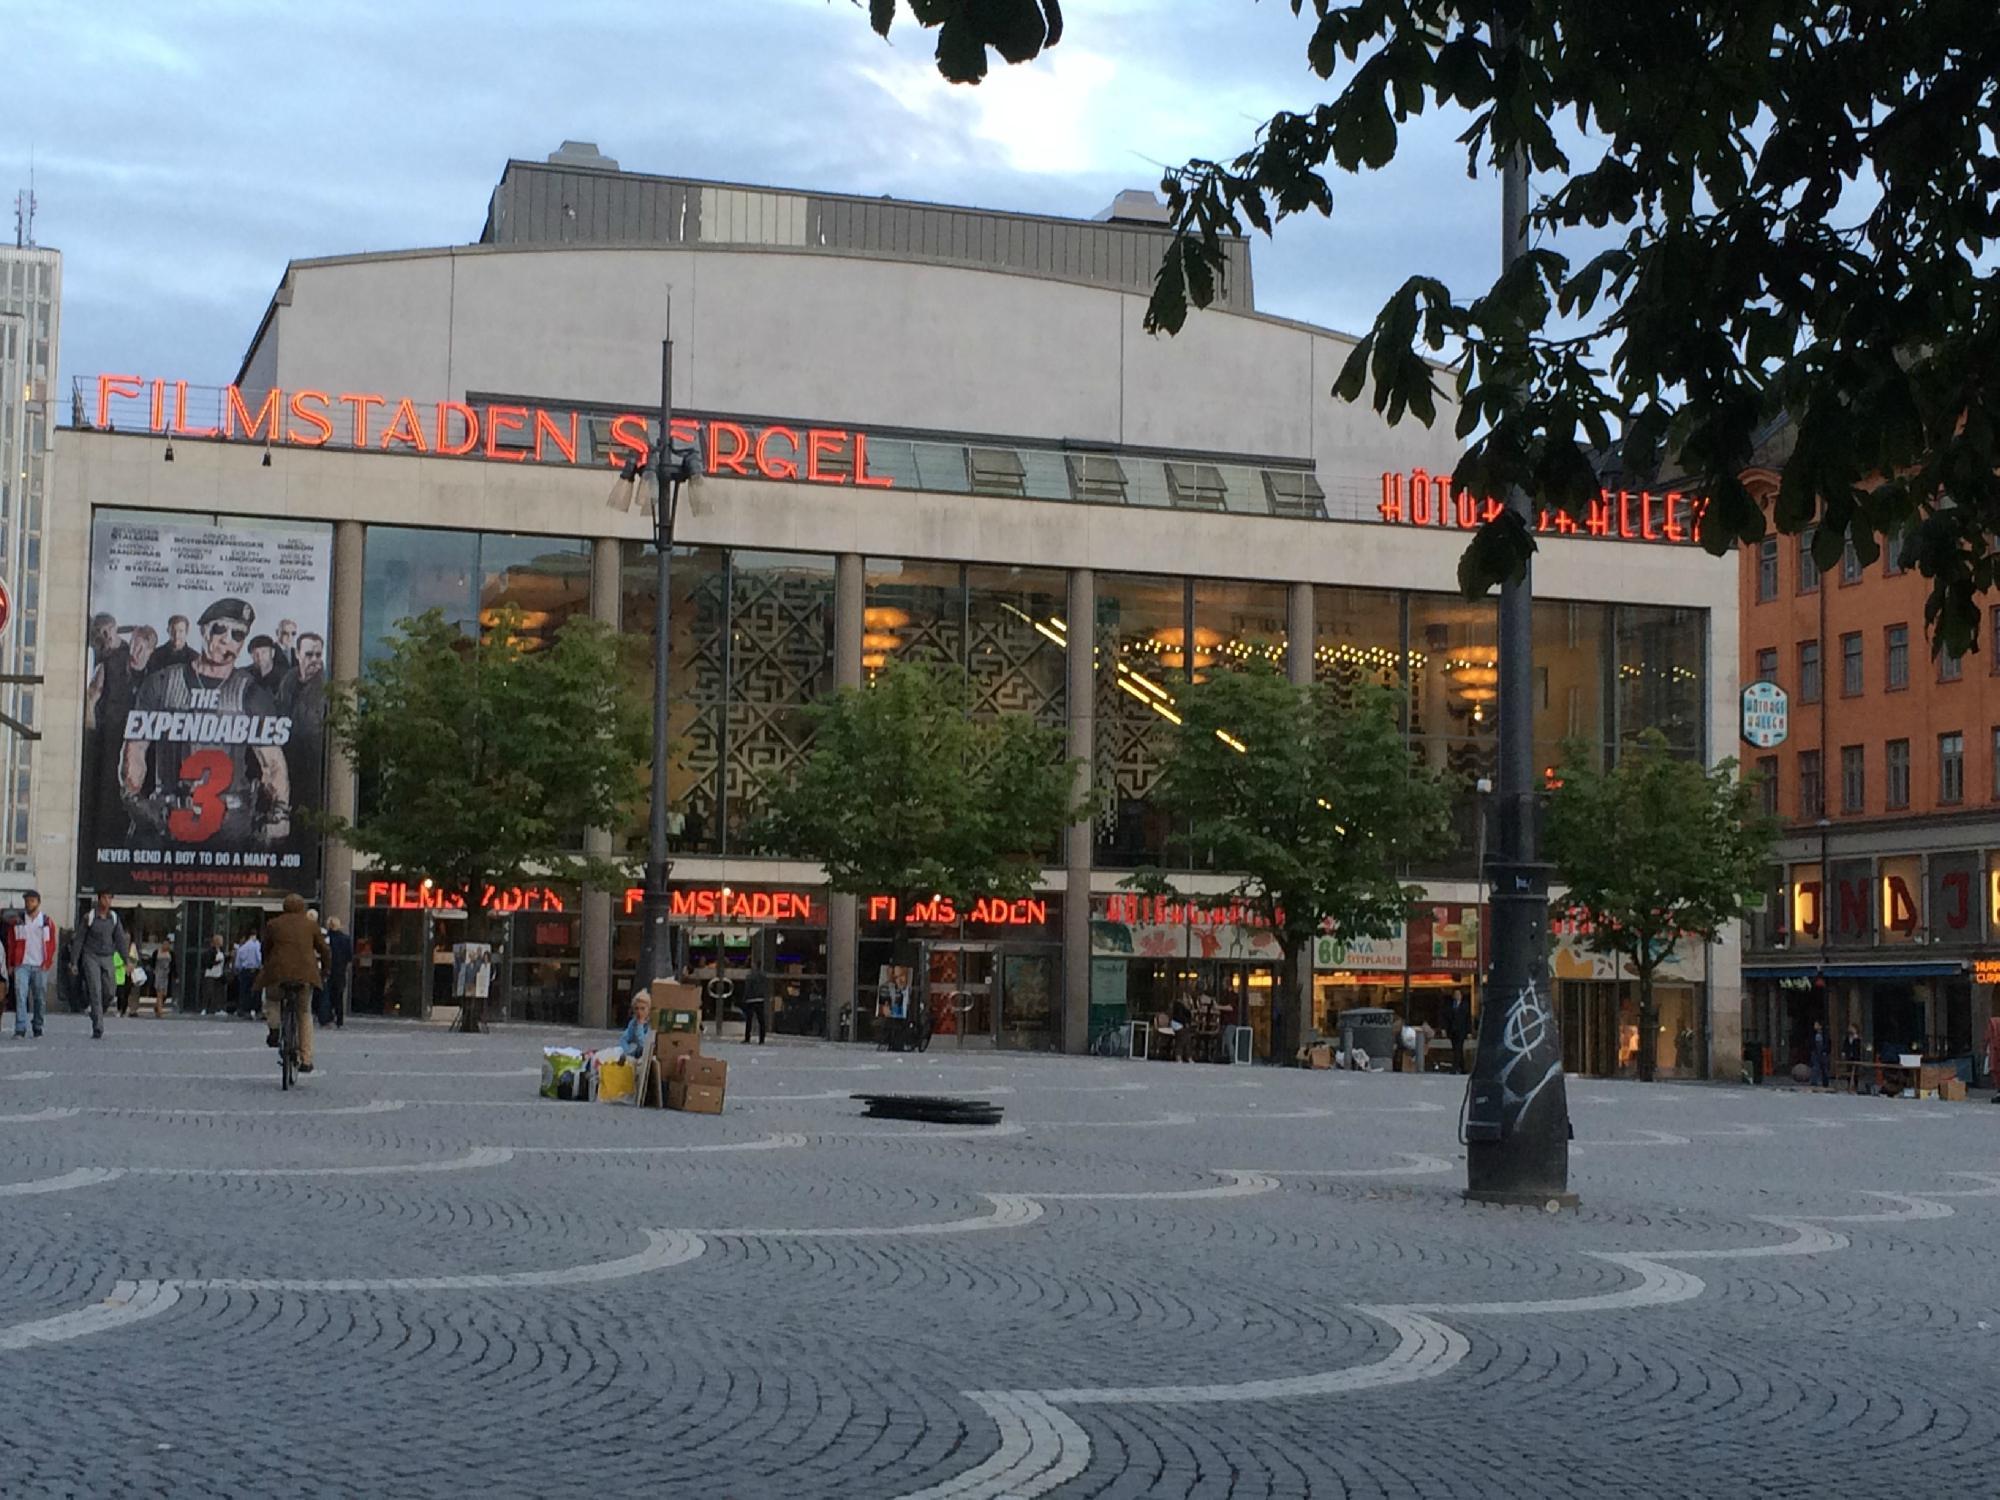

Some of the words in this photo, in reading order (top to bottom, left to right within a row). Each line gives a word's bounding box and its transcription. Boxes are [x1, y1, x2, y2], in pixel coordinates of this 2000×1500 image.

[96, 373, 578, 464] FILMSTADEN
[190, 687, 221, 709] THE
[124, 710, 293, 745] EXPENDABLES
[168, 748, 234, 842] 3
[97, 848, 130, 863] NEVER
[133, 849, 161, 864] SEND
[163, 850, 172, 864] A
[175, 851, 196, 865] BOY
[199, 851, 213, 865] TO
[215, 852, 230, 866] DO
[233, 853, 241, 866] A
[243, 852, 277, 868] MAN'S
[280, 854, 301, 868] JOB
[625, 888, 811, 919] FMSTADEN
